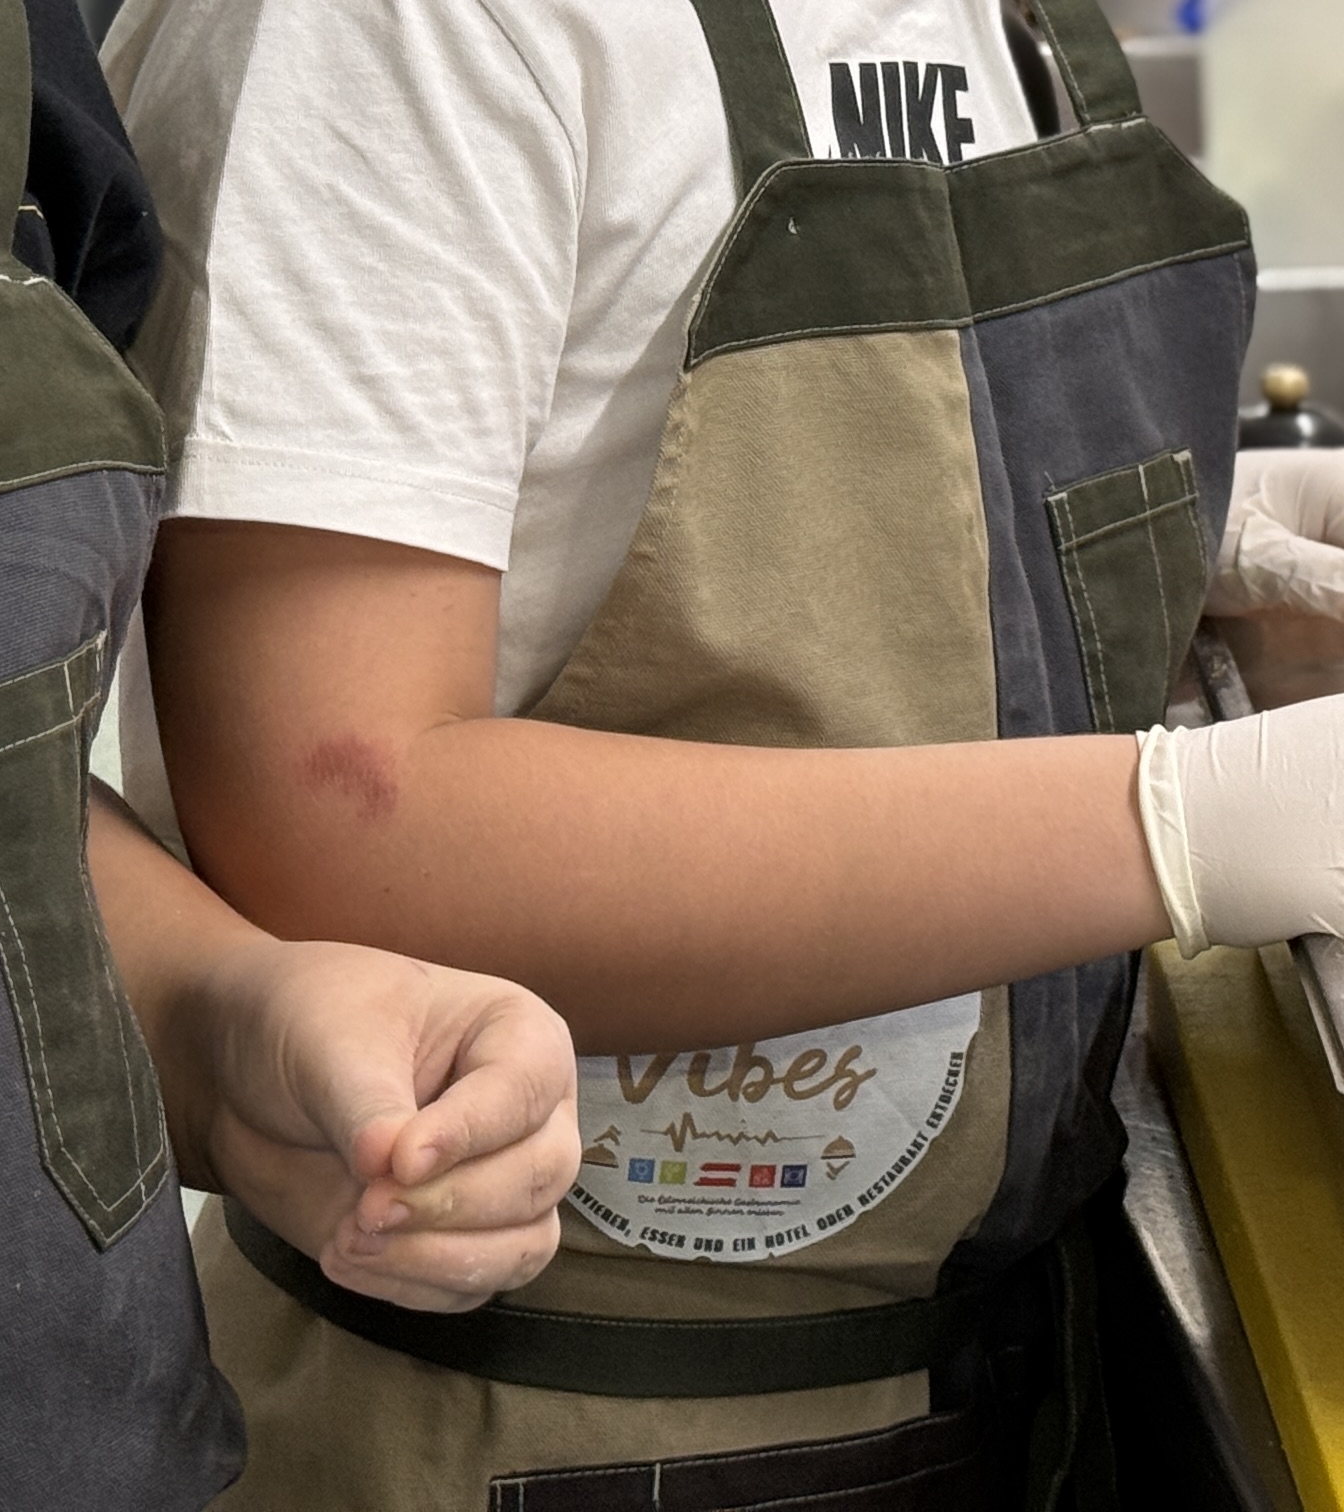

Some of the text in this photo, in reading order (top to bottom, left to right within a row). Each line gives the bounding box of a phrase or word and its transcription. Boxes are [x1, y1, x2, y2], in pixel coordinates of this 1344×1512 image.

[829, 61, 975, 164] NIKE
[616, 1042, 877, 1111] Vibes
[570, 1051, 964, 1253] RVIEREN, ESSEN UND EIN HOTEL ODER RESTAURANT ENTDECKEN
